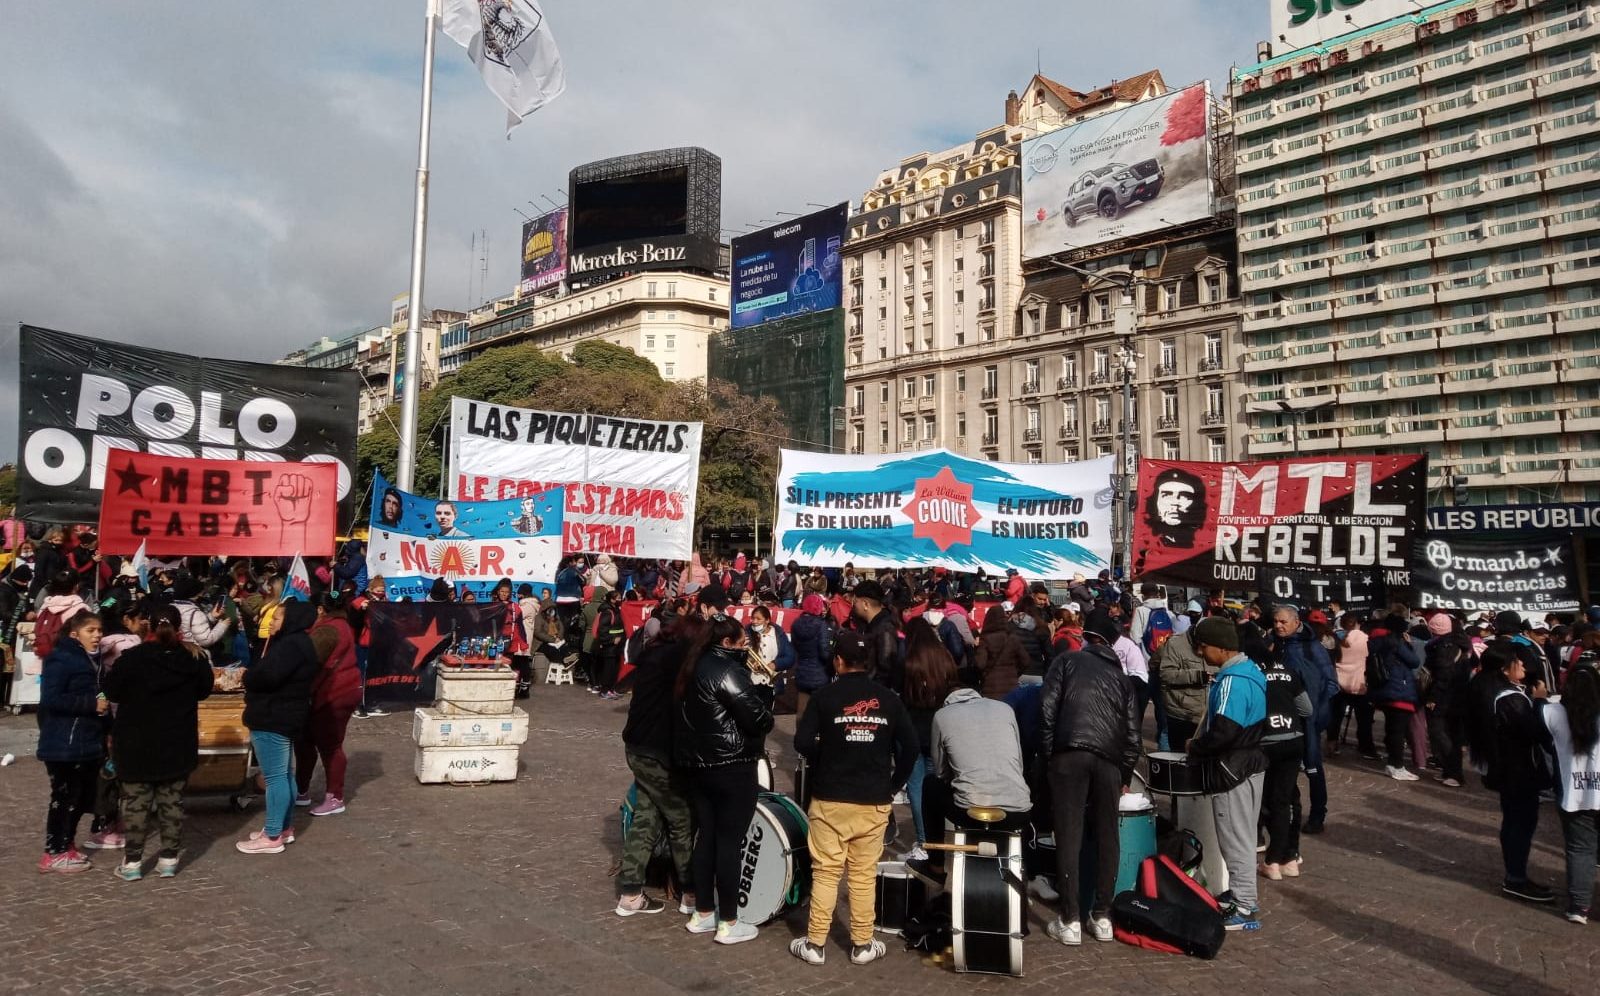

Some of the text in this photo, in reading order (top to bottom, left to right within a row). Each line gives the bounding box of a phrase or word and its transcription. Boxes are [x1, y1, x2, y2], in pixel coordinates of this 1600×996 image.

[1095, 132, 1121, 147] NISSAN
[1122, 122, 1160, 140] FRONTIER
[774, 223, 801, 239] telecom
[570, 243, 686, 274] Mercedes-Benz
[748, 264, 764, 275] nube
[740, 276, 763, 289] medida
[740, 287, 763, 300] negocio
[76, 373, 297, 450] POLO
[467, 402, 689, 453] LAS PIQUETERAS
[457, 474, 493, 502] LE
[786, 485, 902, 511] SI EL PRESENTE
[1218, 461, 1407, 517] MTL
[917, 497, 969, 530] COOKE
[997, 496, 1084, 516] EL FUTURO
[130, 509, 253, 537] CABA
[795, 512, 893, 531] ES DE LUCHA
[991, 520, 1090, 540] ES NUESTRO
[1217, 515, 1393, 526] MOVIMIENTO TERRITORIAL LIBERACION
[1215, 525, 1406, 568] REBELDE
[400, 541, 514, 577] M.A.R.
[1213, 563, 1256, 581] CIUDAD
[1442, 572, 1567, 593] Conciencias
[1265, 672, 1292, 682] arzo
[833, 715, 889, 726] BATUCADA
[1269, 713, 1293, 730] Ely
[448, 759, 479, 770] AQUA
